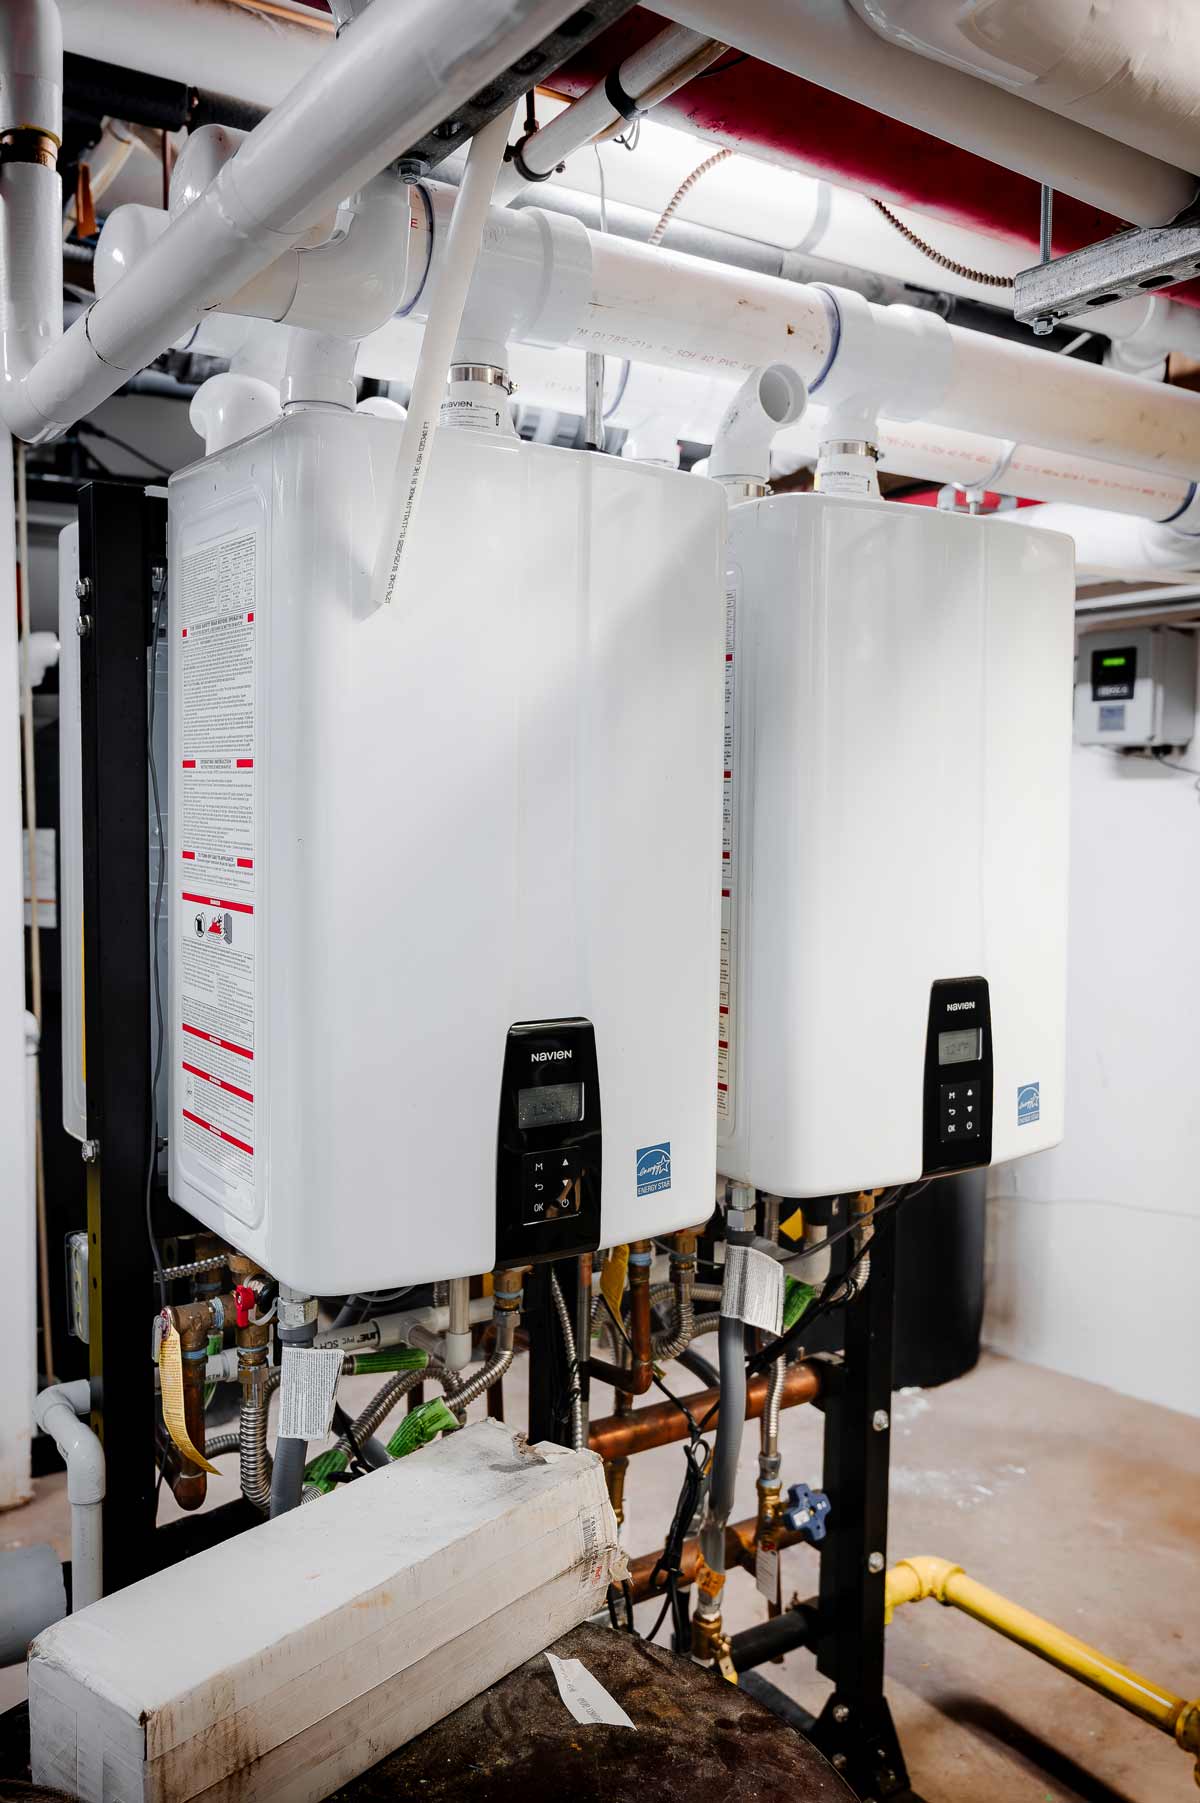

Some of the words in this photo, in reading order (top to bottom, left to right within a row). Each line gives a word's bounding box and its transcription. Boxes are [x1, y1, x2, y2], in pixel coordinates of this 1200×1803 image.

[535, 1162, 543, 1171] M
[637, 1184, 658, 1195] ENERGY
[657, 1180, 671, 1191] STAR
[533, 1202, 544, 1213] OK
